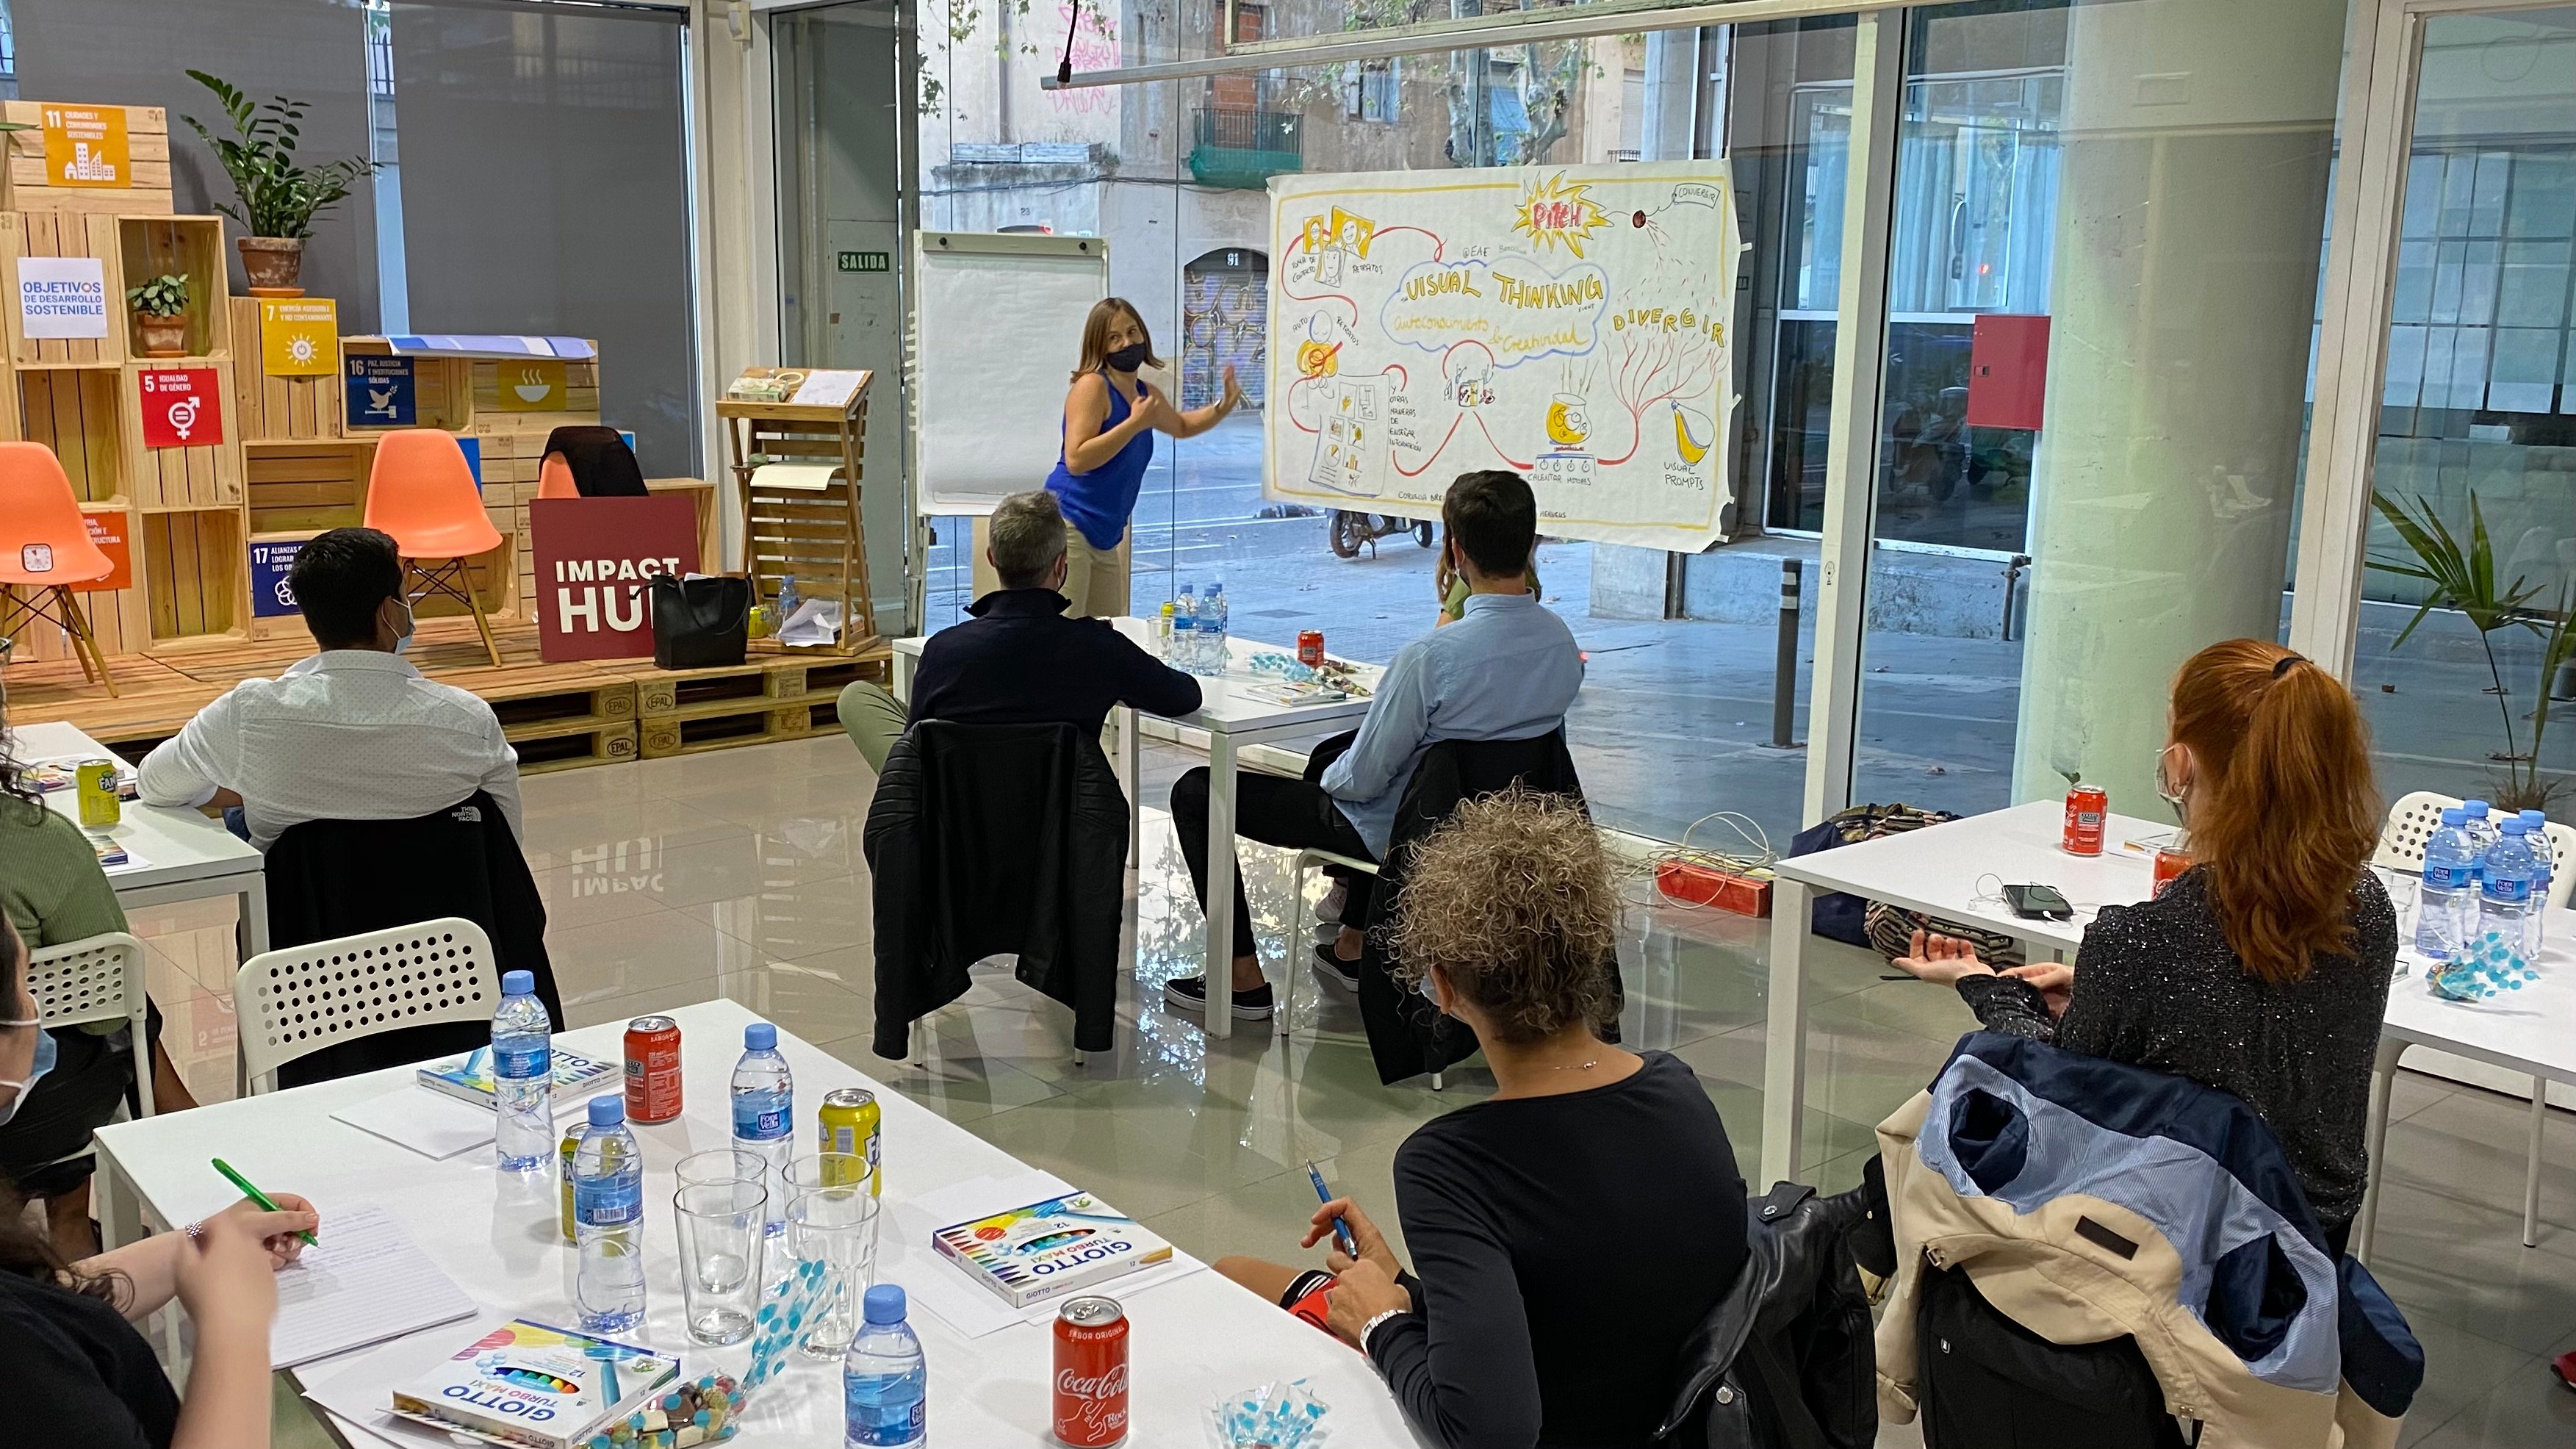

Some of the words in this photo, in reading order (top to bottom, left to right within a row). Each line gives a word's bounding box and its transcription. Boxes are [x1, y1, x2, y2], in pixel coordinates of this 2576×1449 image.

[46, 110, 61, 129] 11
[841, 254, 886, 270] SALIDA
[1227, 253, 1239, 266] 91
[23, 281, 101, 293] OBJETIVOS
[1406, 270, 1482, 301] VISUAL
[1492, 270, 1604, 309] THINKING
[24, 295, 37, 303] DE
[39, 295, 102, 303] DESARROLLO
[25, 304, 104, 314] SOSTENIBLE
[267, 305, 274, 322] 7
[1613, 308, 1724, 348] DIVERGIR
[350, 359, 364, 375] 16
[144, 375, 155, 392] 5
[159, 374, 188, 382] IGUALDAD
[159, 384, 168, 392] DE
[168, 382, 191, 392] GÉNERO
[1664, 461, 1697, 475] VISUAL
[1528, 473, 1562, 483] CALENTAR
[1665, 475, 1704, 490] PROMPTS
[253, 547, 268, 564] 17
[270, 546, 298, 554] ALIANZAS
[555, 558, 680, 583] IMPACT
[558, 585, 654, 633] HU
[1066, 1237, 1112, 1253] TURBO
[1030, 1249, 1065, 1263] MAXI
[1032, 1240, 1132, 1275] GIOTTO
[1026, 1287, 1051, 1300] GIOTTO
[1095, 1325, 1126, 1340] ORIGINAL
[469, 1380, 508, 1394] MAXI
[443, 1386, 555, 1422] GIOTTO
[508, 1390, 558, 1407] TURBO
